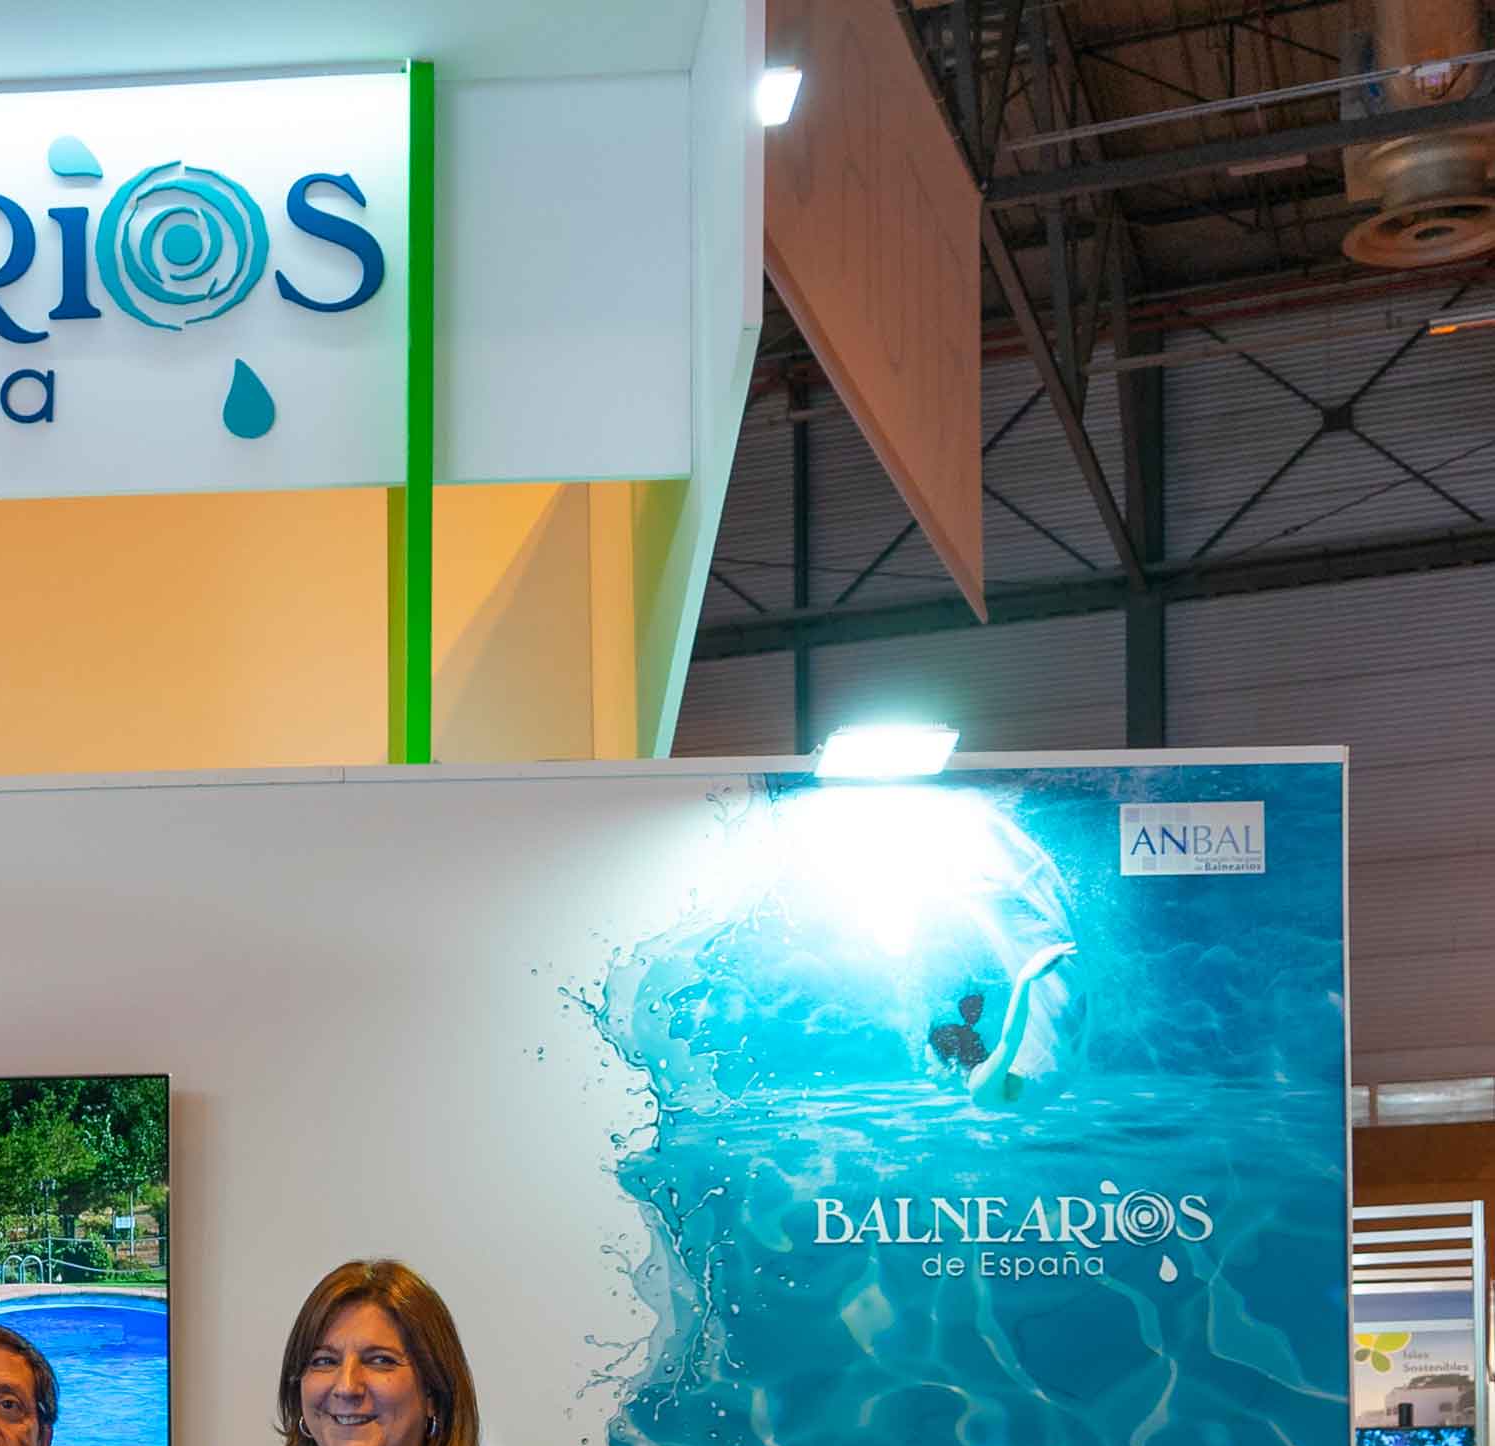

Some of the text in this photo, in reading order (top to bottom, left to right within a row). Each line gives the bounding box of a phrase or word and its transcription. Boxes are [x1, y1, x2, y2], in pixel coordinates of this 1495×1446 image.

[1130, 824, 1262, 855] ANBAL
[922, 1251, 1105, 1281] de España
